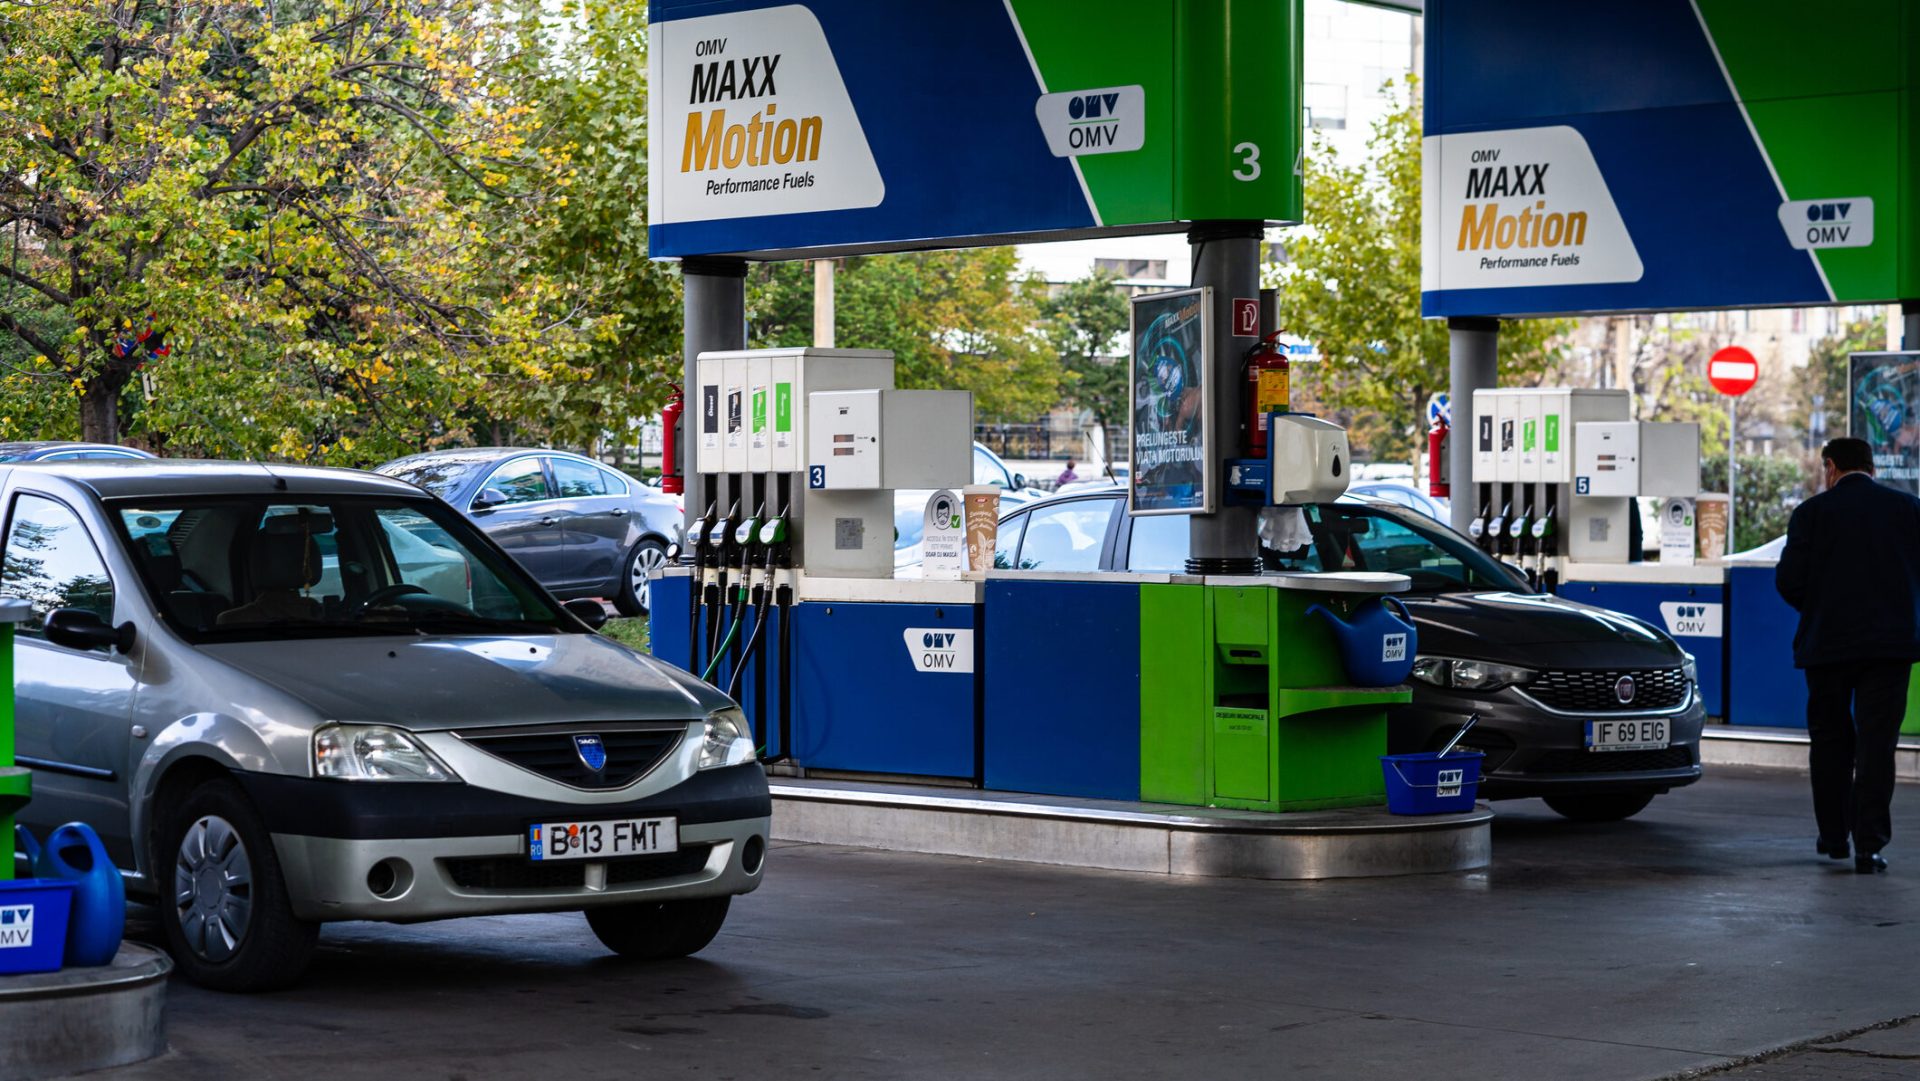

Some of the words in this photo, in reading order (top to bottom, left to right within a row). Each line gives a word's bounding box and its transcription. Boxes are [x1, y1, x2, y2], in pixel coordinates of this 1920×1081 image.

[696, 37, 727, 56] OMV
[690, 54, 781, 105] MAXX
[681, 104, 823, 173] Motion
[1069, 124, 1119, 149] OMV
[1232, 142, 1261, 182] 3
[1471, 149, 1500, 163] OMV
[706, 177, 780, 196] Performance
[782, 172, 815, 190] Fuels
[1466, 162, 1550, 199] MAXX
[1457, 201, 1588, 251] Motion
[1806, 226, 1851, 244] OMV
[1480, 256, 1548, 270] Performance
[1550, 253, 1580, 267] Fuels
[812, 467, 823, 487] 3
[1578, 478, 1588, 493] 5
[1676, 621, 1705, 633] OMV
[923, 653, 955, 668] OMV
[1385, 649, 1403, 659] OMV
[1599, 723, 1613, 743] IF
[1618, 722, 1636, 742] 69
[1641, 722, 1664, 741] EIG
[550, 826, 569, 856] B
[580, 825, 603, 853] 13
[613, 821, 661, 852] FMT
[530, 844, 542, 857] RO
[0, 929, 30, 944] MV
